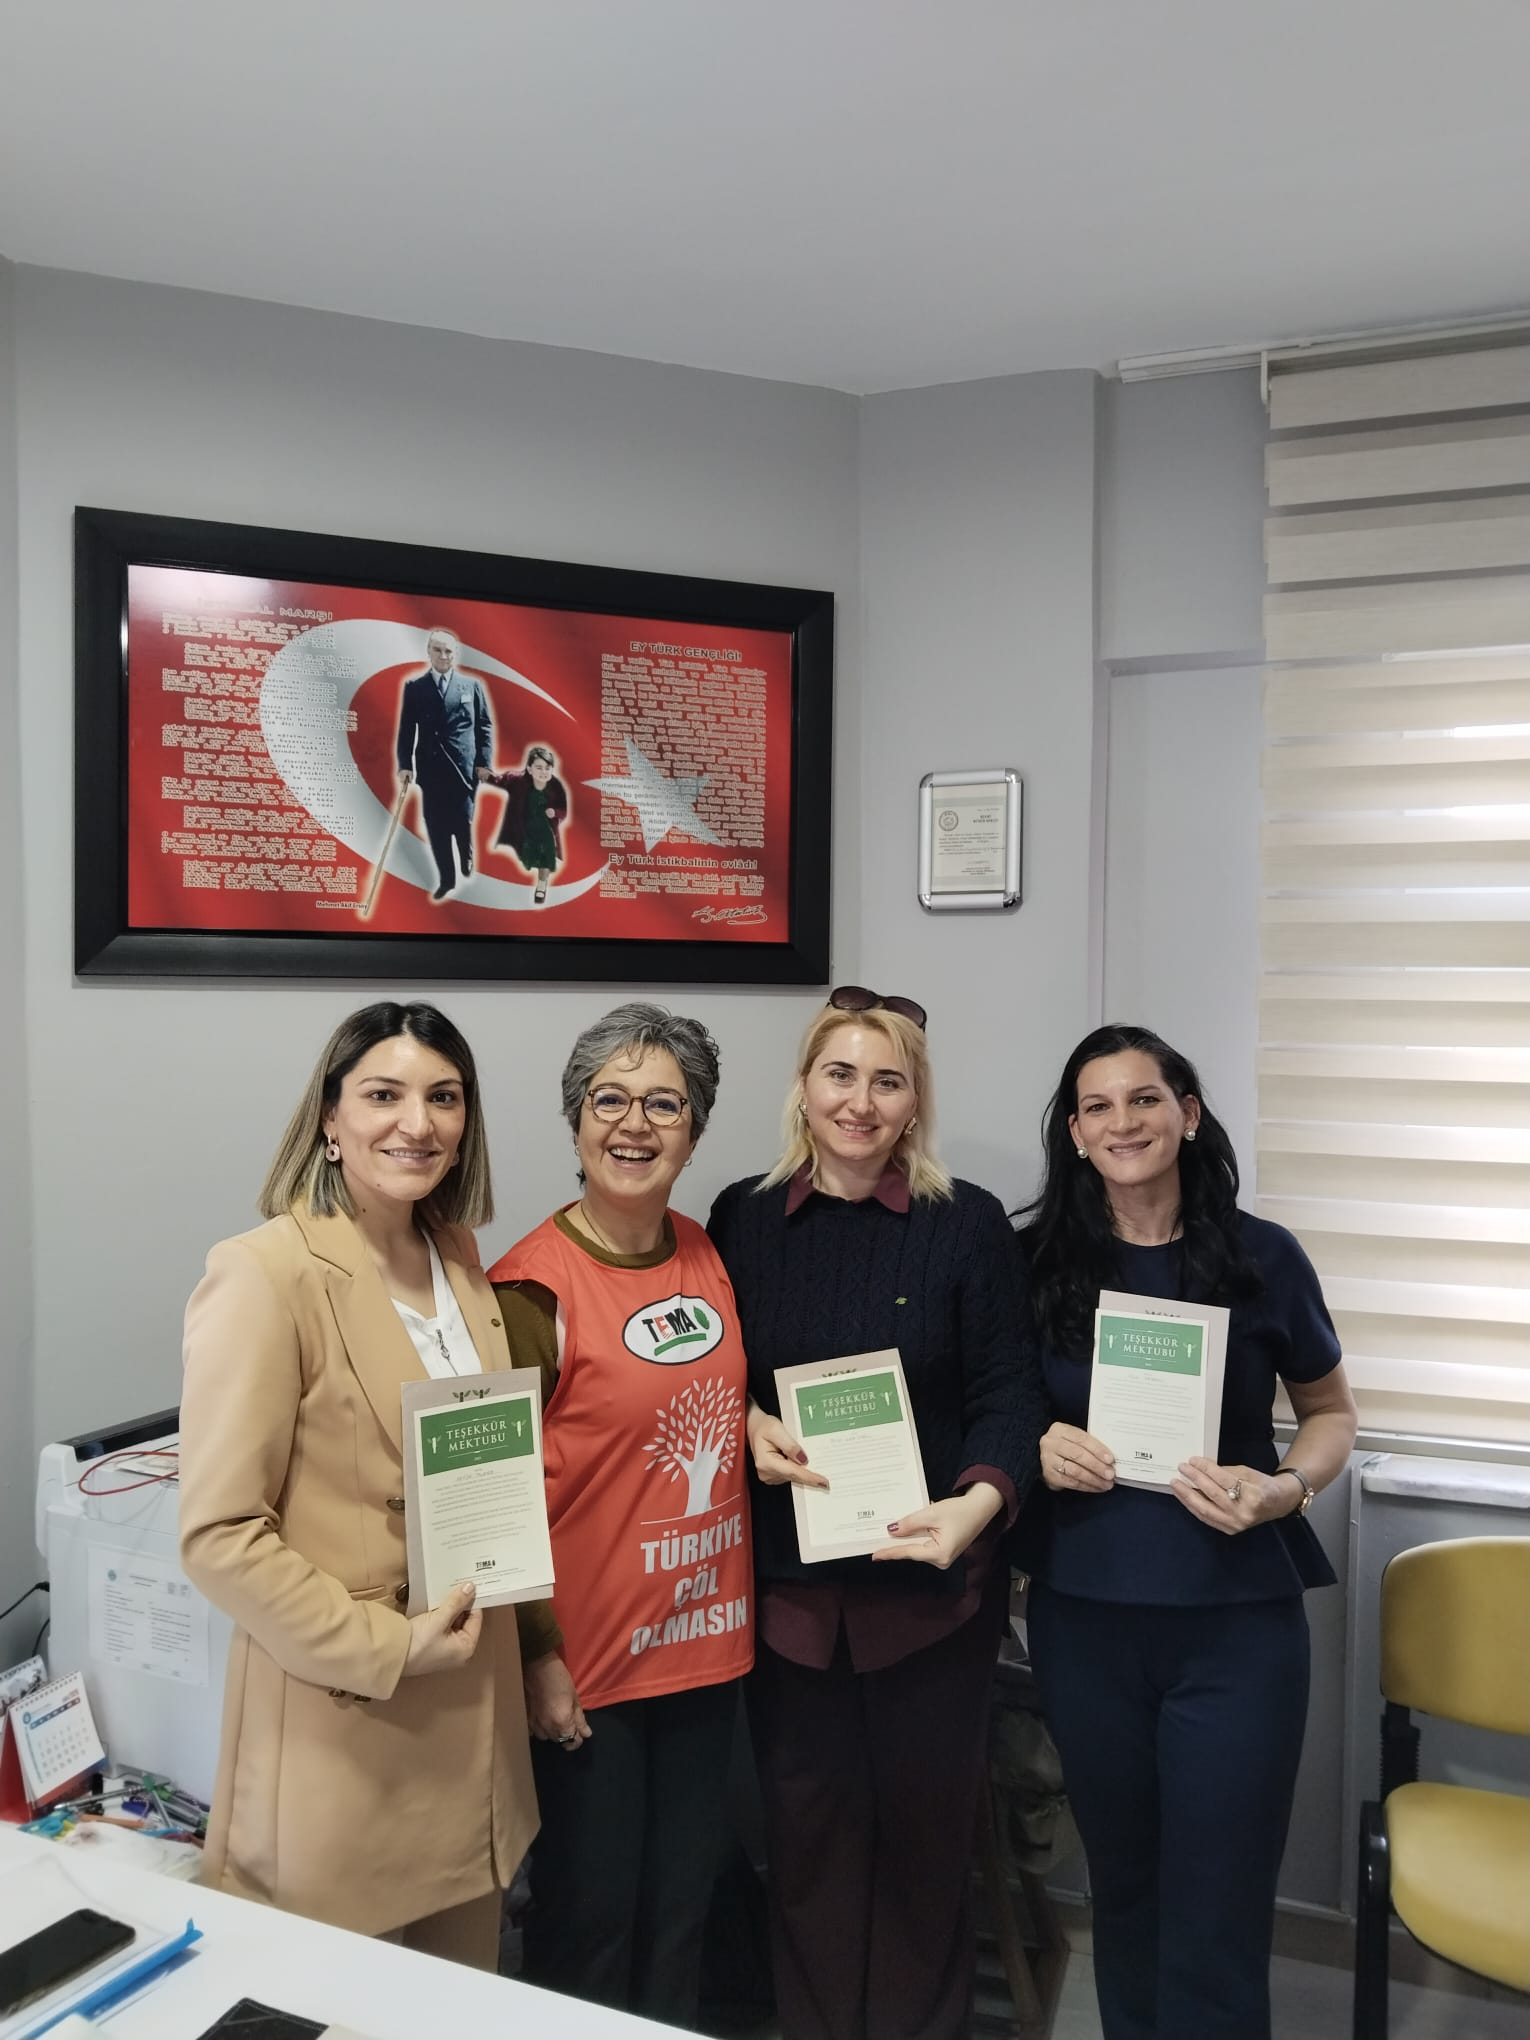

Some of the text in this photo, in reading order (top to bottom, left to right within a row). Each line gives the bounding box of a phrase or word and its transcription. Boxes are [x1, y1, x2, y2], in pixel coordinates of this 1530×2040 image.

[280, 607, 333, 622] MARŞI
[631, 642, 646, 652] EY
[649, 643, 681, 656] TÜRK
[609, 854, 624, 866] Ey
[628, 854, 655, 865] Türk
[657, 856, 718, 868] istikbalinin
[641, 1308, 698, 1343] TEMA
[1122, 1333, 1178, 1347] TEŞEKKÜR
[1123, 1344, 1177, 1358] MEKTUBU
[823, 1392, 876, 1408] TEŞEKKÜR
[824, 1402, 876, 1419] MEKTUBU
[446, 1421, 507, 1440] TEŞEKKÜR
[448, 1433, 506, 1453] MEKTUBU
[640, 1513, 743, 1574] TÜRKİYE
[674, 1563, 719, 1611] ÇÖL
[630, 1596, 747, 1656] OLMASIN
